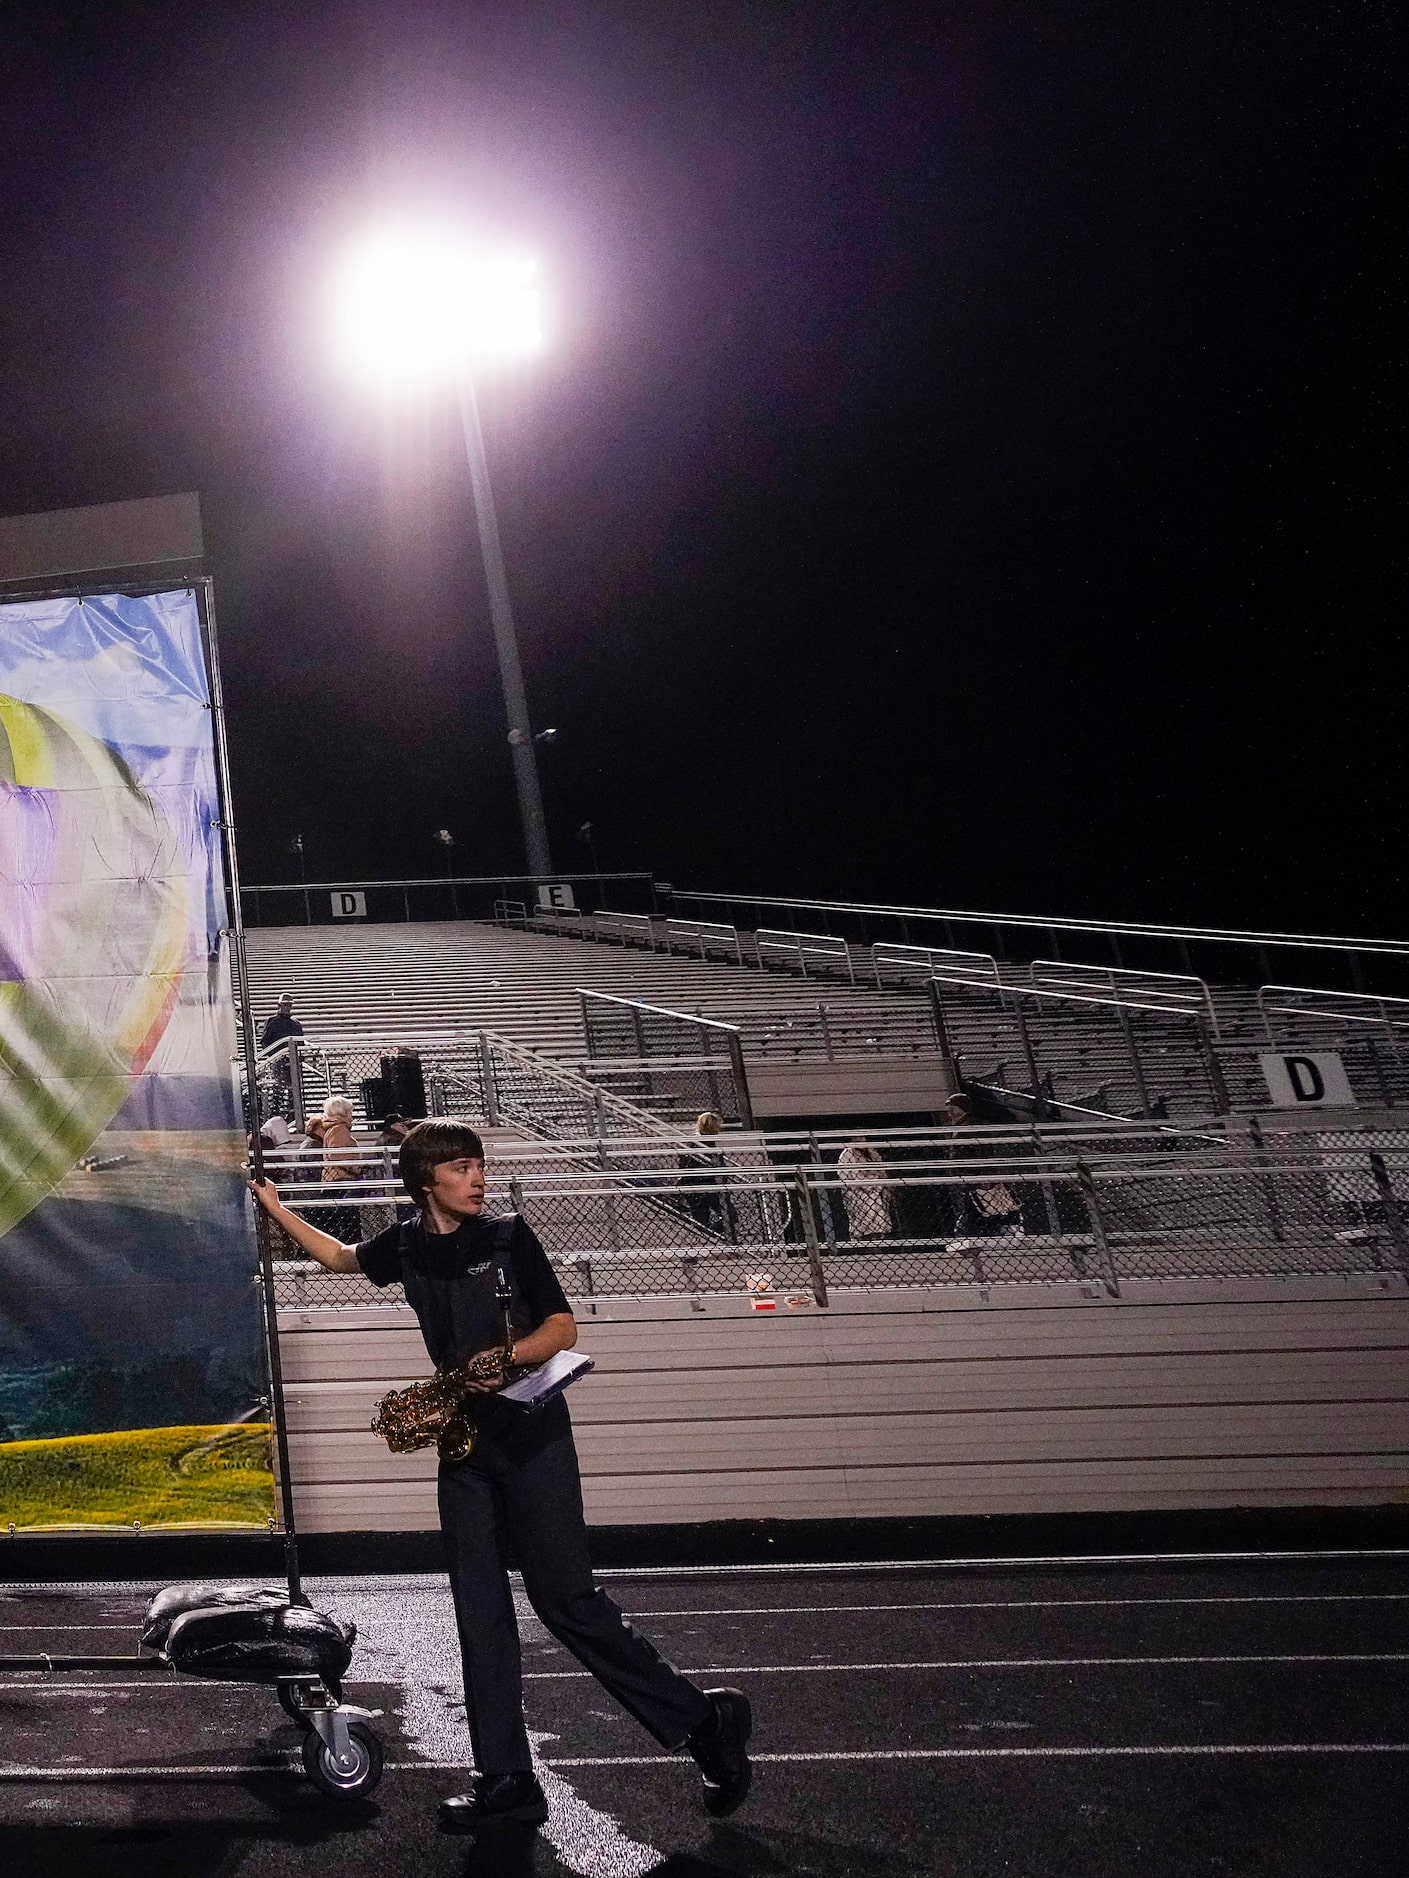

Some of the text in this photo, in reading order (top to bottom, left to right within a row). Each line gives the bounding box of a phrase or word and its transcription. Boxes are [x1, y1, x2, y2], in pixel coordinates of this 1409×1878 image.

[340, 893, 357, 915] D
[547, 886, 566, 907] E
[1283, 1056, 1325, 1101] D
